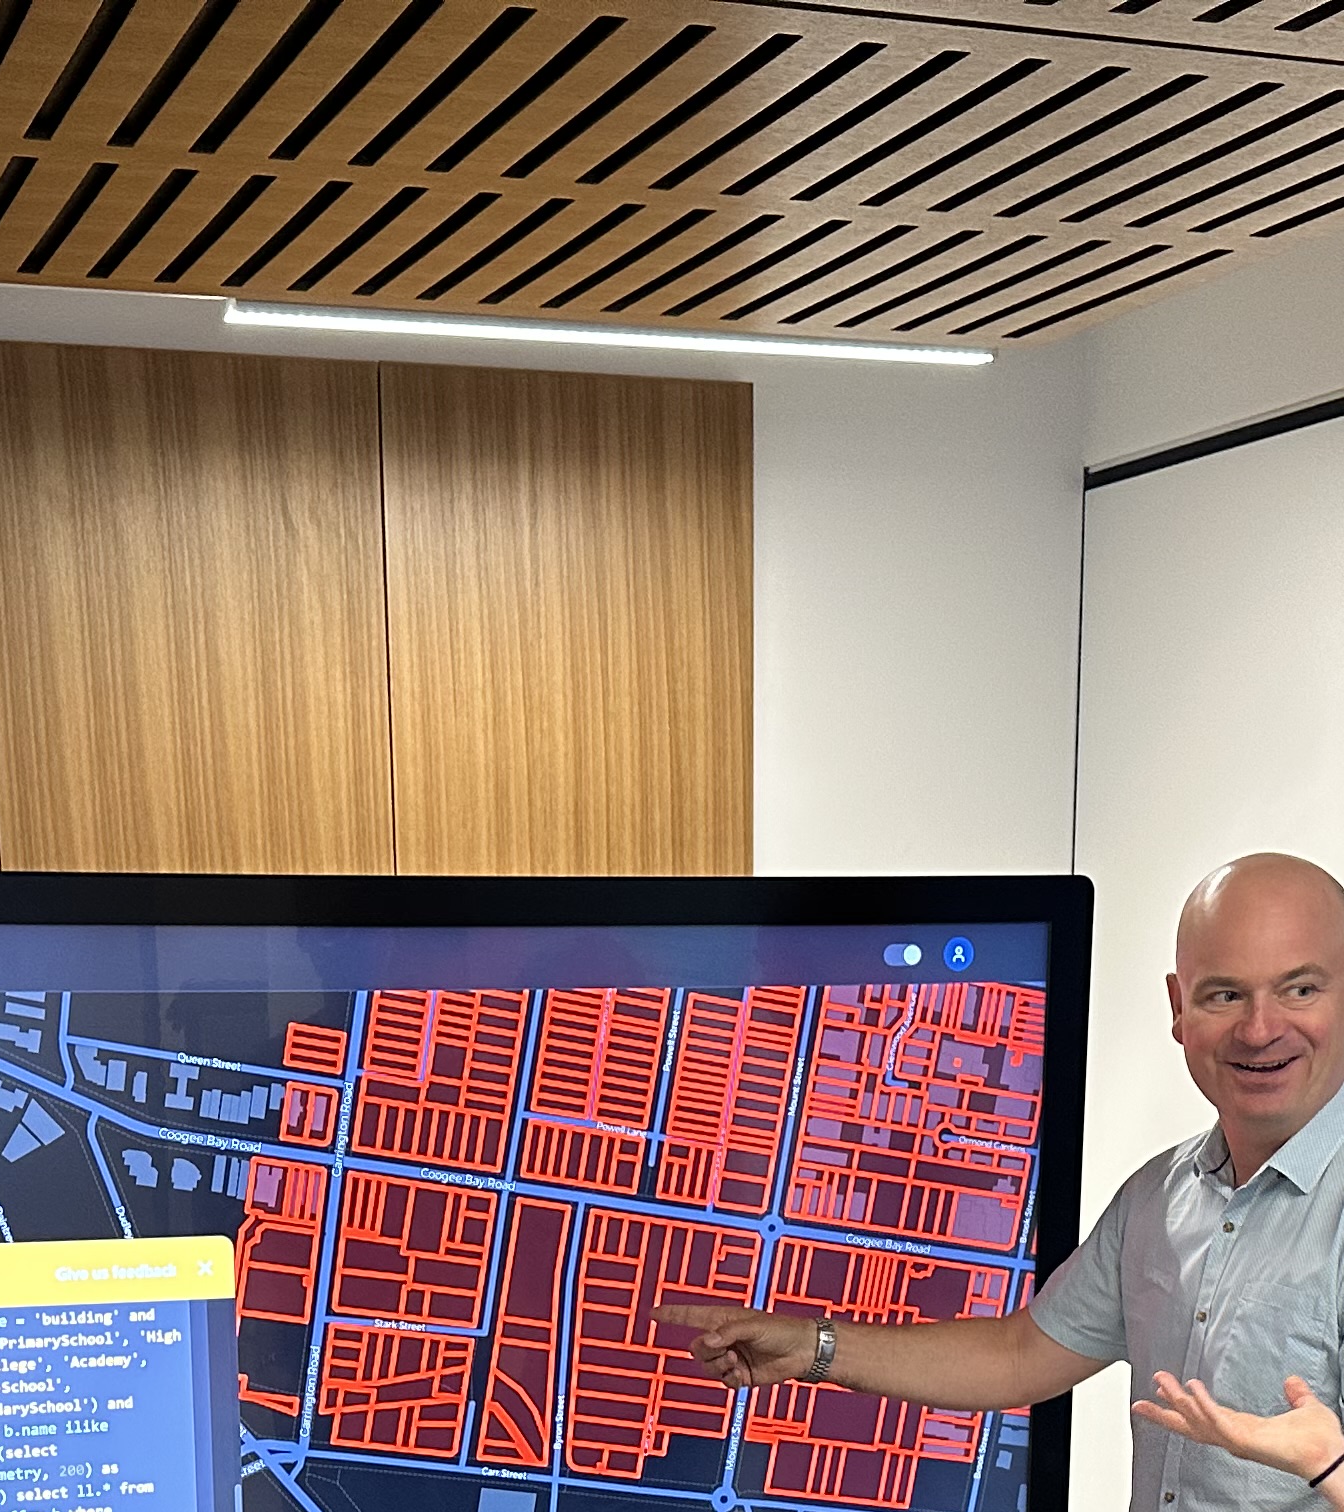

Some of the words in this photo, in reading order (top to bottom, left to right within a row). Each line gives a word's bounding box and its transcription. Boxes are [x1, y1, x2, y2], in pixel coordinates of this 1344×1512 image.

[663, 1039, 677, 1073] Powell
[672, 1009, 681, 1039] Street
[177, 1052, 212, 1067] Queen
[211, 1057, 242, 1072] Street
[793, 1057, 805, 1084] Street
[340, 1081, 354, 1115] Road
[787, 1083, 801, 1117] Mount
[158, 1127, 204, 1145] Coogee
[206, 1134, 230, 1151] Bay
[231, 1138, 262, 1153] Road
[596, 1121, 626, 1136] Powell
[626, 1127, 648, 1138] Lane
[332, 1114, 350, 1178] Carrington
[420, 1167, 463, 1184] Coogee
[464, 1174, 486, 1191] Bay
[487, 1177, 517, 1192] Road
[1019, 1217, 1031, 1244] Brook
[1025, 1190, 1036, 1217] Street
[845, 1232, 883, 1249] Coogee
[885, 1238, 904, 1253] Bay
[905, 1240, 932, 1254] Road
[54, 1265, 89, 1282] Give
[91, 1266, 109, 1280] us
[111, 1263, 177, 1280] feedback
[35, 1309, 119, 1327] 'building'
[129, 1308, 156, 1323] and
[373, 1318, 398, 1330] Stark
[398, 1321, 426, 1333] Street
[140, 1329, 182, 1345] 'High
[63, 1351, 147, 1369] 'Academy',
[307, 1345, 321, 1378] Road
[107, 1396, 134, 1410] and
[299, 1377, 317, 1438] Carrington
[555, 1393, 566, 1422] Street
[731, 1400, 745, 1432] Street
[4, 1424, 57, 1438] b.name
[65, 1419, 109, 1435] ilike
[978, 1426, 990, 1454] Street
[724, 1432, 739, 1471] Mount
[59, 1461, 93, 1478] 200)
[101, 1463, 119, 1475] as
[240, 1458, 266, 1478] reet
[481, 1466, 501, 1479] Carr
[501, 1468, 527, 1480] Street
[16, 1485, 69, 1502] select
[119, 1481, 155, 1495] from
